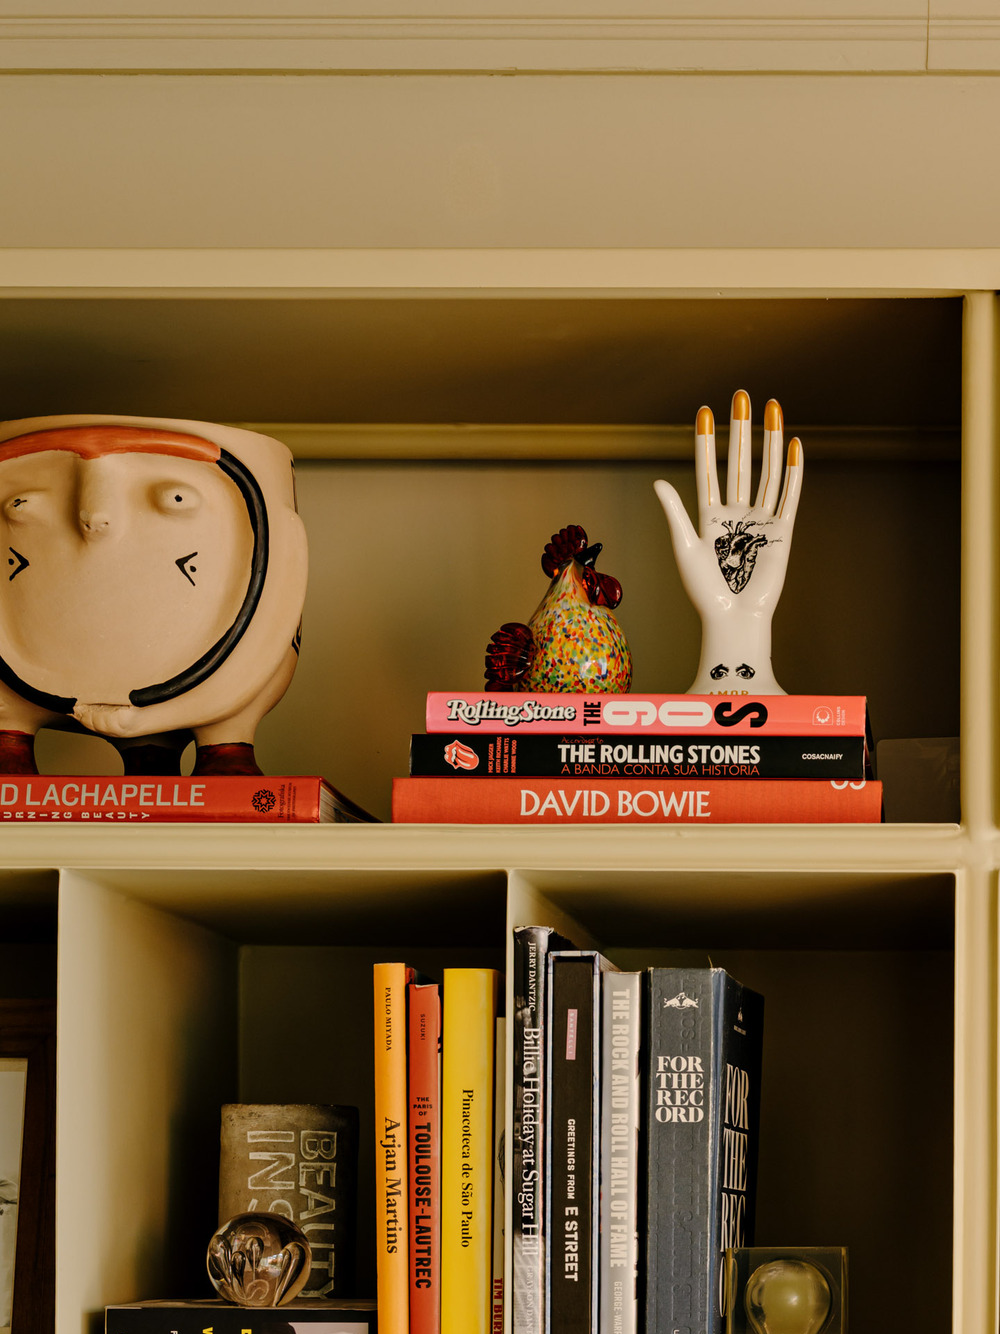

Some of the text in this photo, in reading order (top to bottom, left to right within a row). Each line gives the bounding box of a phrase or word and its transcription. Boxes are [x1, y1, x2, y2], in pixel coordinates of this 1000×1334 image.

[584, 701, 601, 726] THE
[558, 745, 761, 764] THE ROLLING STONES
[561, 764, 698, 775] A BANDA CONTA SUA
[25, 784, 206, 806] LACHAPELLE
[520, 790, 711, 817] DAVID BOWIE
[528, 943, 537, 1011] JERRY DANTZIC
[656, 1073, 703, 1089] THE
[657, 1056, 703, 1071] FOR
[655, 1107, 704, 1122] ORD
[656, 1090, 704, 1106] REC
[725, 1064, 749, 1130] FOR
[519, 1026, 540, 1256] Billie Holiday Sugar Hill
[609, 989, 630, 1267] THE ROCK AND ROLL HALL OF FAME
[380, 1117, 402, 1254] Arjan Martins
[460, 1089, 475, 1248] Pinacoteca de São Paulo
[723, 1129, 747, 1191] THE
[298, 1130, 337, 1299] BEAUTY
[415, 1122, 432, 1289] TOULOUSE-LAUTREC
[564, 1118, 578, 1282] GREETINGS FROM E STREET
[720, 1192, 746, 1252] REC
